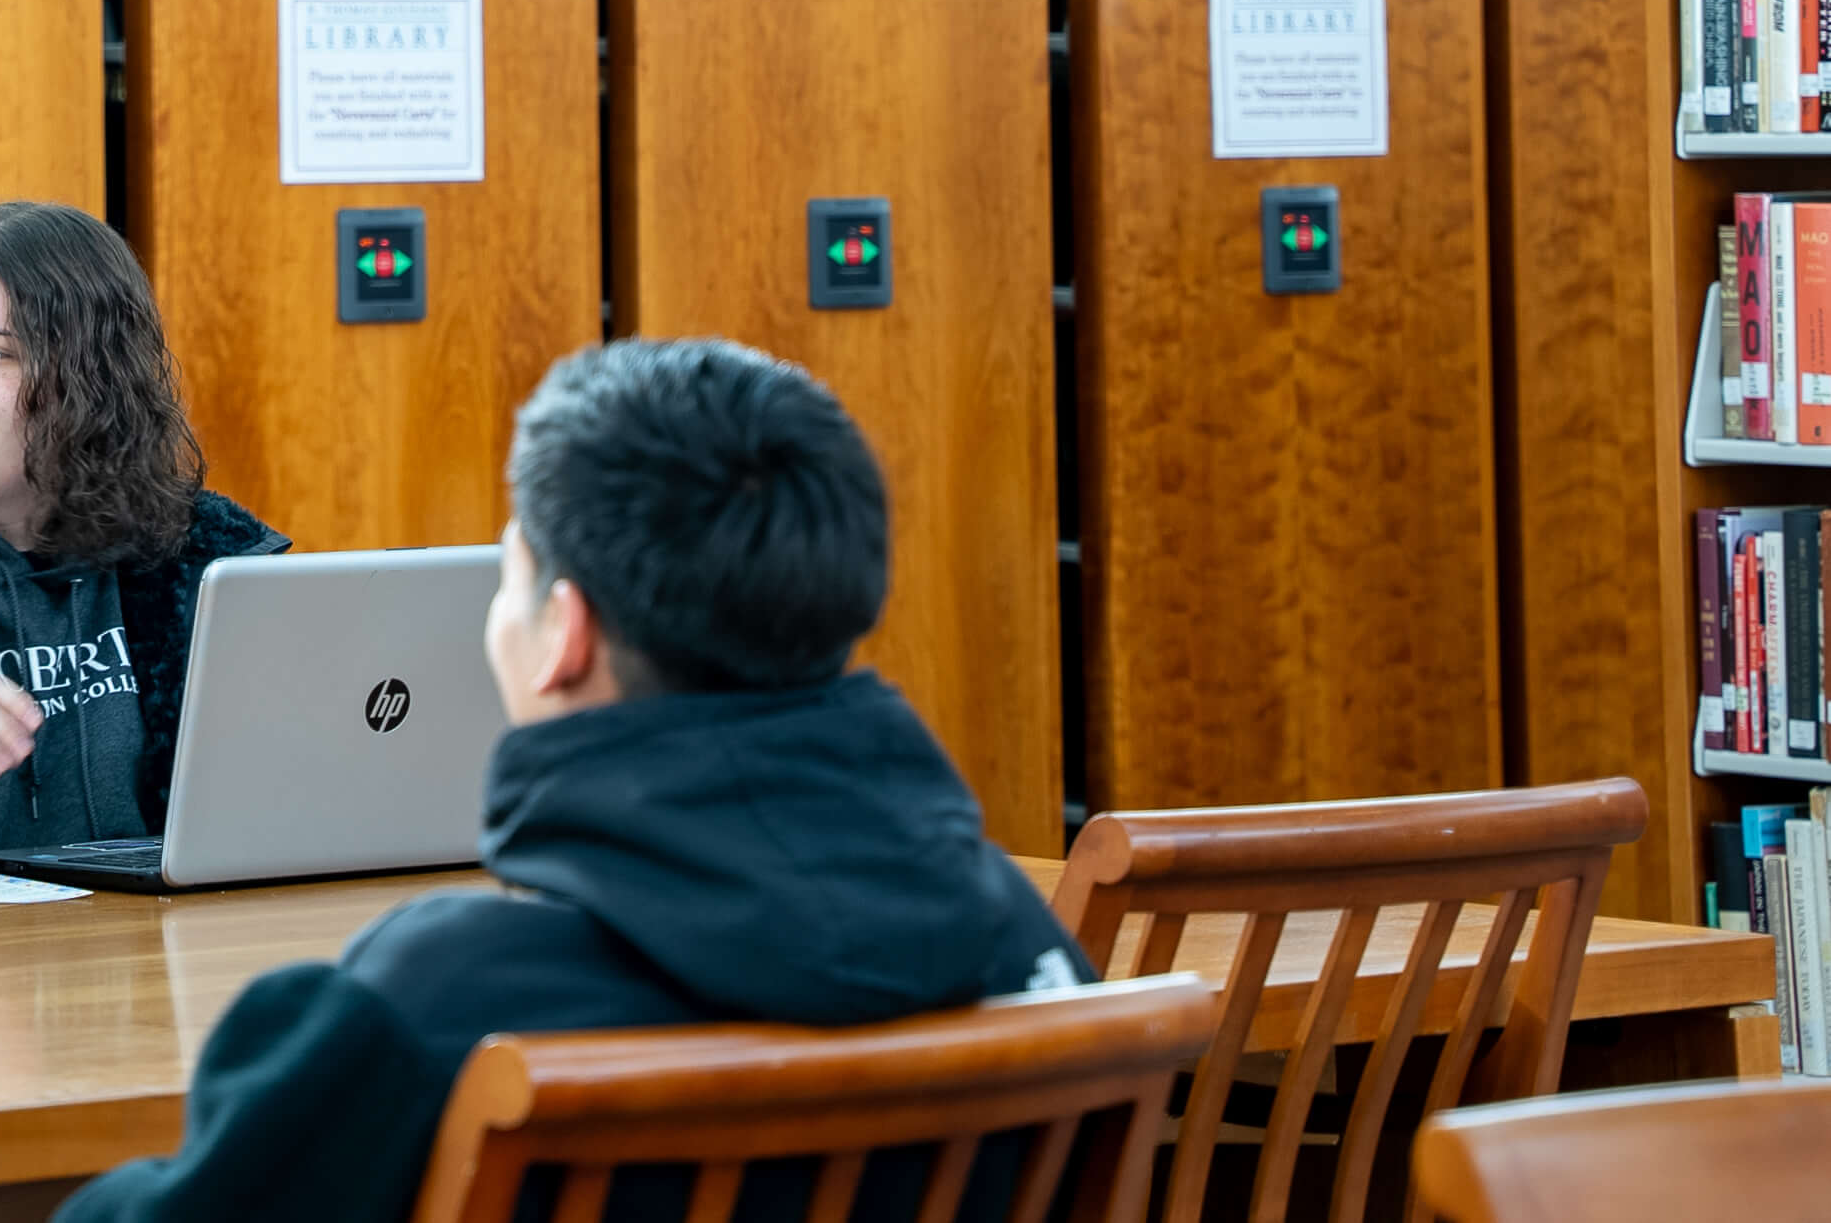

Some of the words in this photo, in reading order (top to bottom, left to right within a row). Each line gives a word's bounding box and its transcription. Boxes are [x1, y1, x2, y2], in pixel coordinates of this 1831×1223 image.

[305, 25, 449, 50] LIBRARY
[1232, 10, 1355, 34] LIBRARY
[1704, 23, 1714, 67] CHINA
[1800, 232, 1828, 245] MAO
[1739, 221, 1764, 357] MAO
[1767, 570, 1778, 626] CHARM
[369, 677, 407, 733] hp
[1753, 860, 1763, 894] JAPAN
[1794, 867, 1803, 891] THE
[1755, 896, 1763, 910] IN
[1794, 898, 1808, 964] JAPANESE
[1801, 971, 1811, 1012] TODAY
